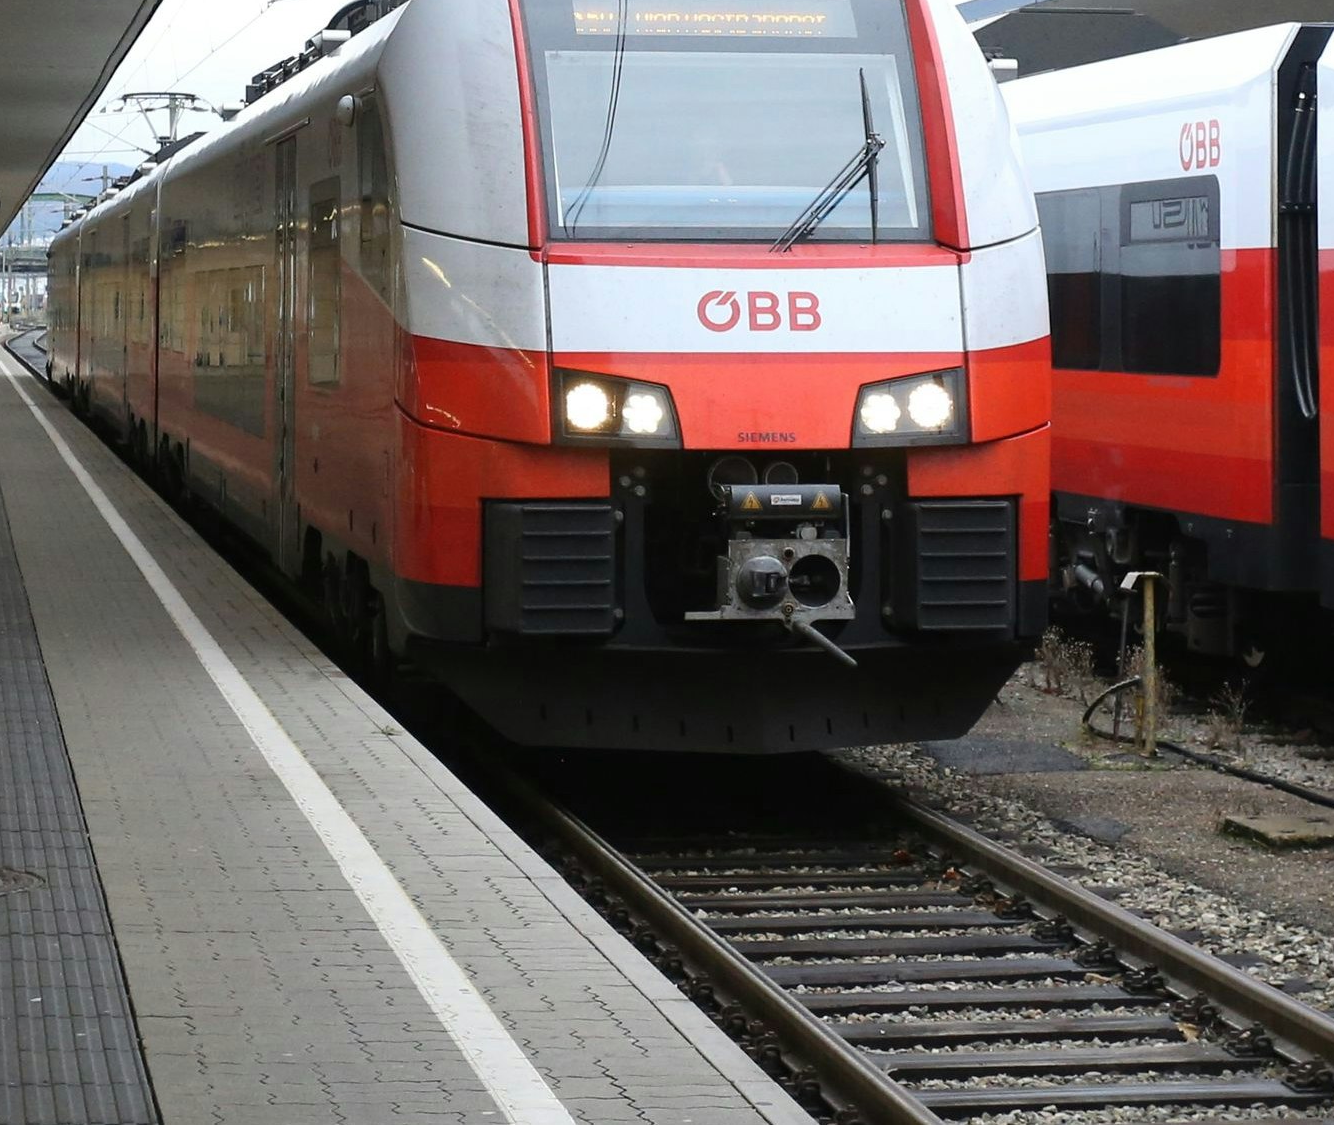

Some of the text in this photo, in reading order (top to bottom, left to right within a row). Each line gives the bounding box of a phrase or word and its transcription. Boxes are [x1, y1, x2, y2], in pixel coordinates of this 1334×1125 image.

[1179, 119, 1220, 171] ÖBB
[697, 290, 822, 332] ÖBB
[737, 432, 796, 443] SIEMENS
